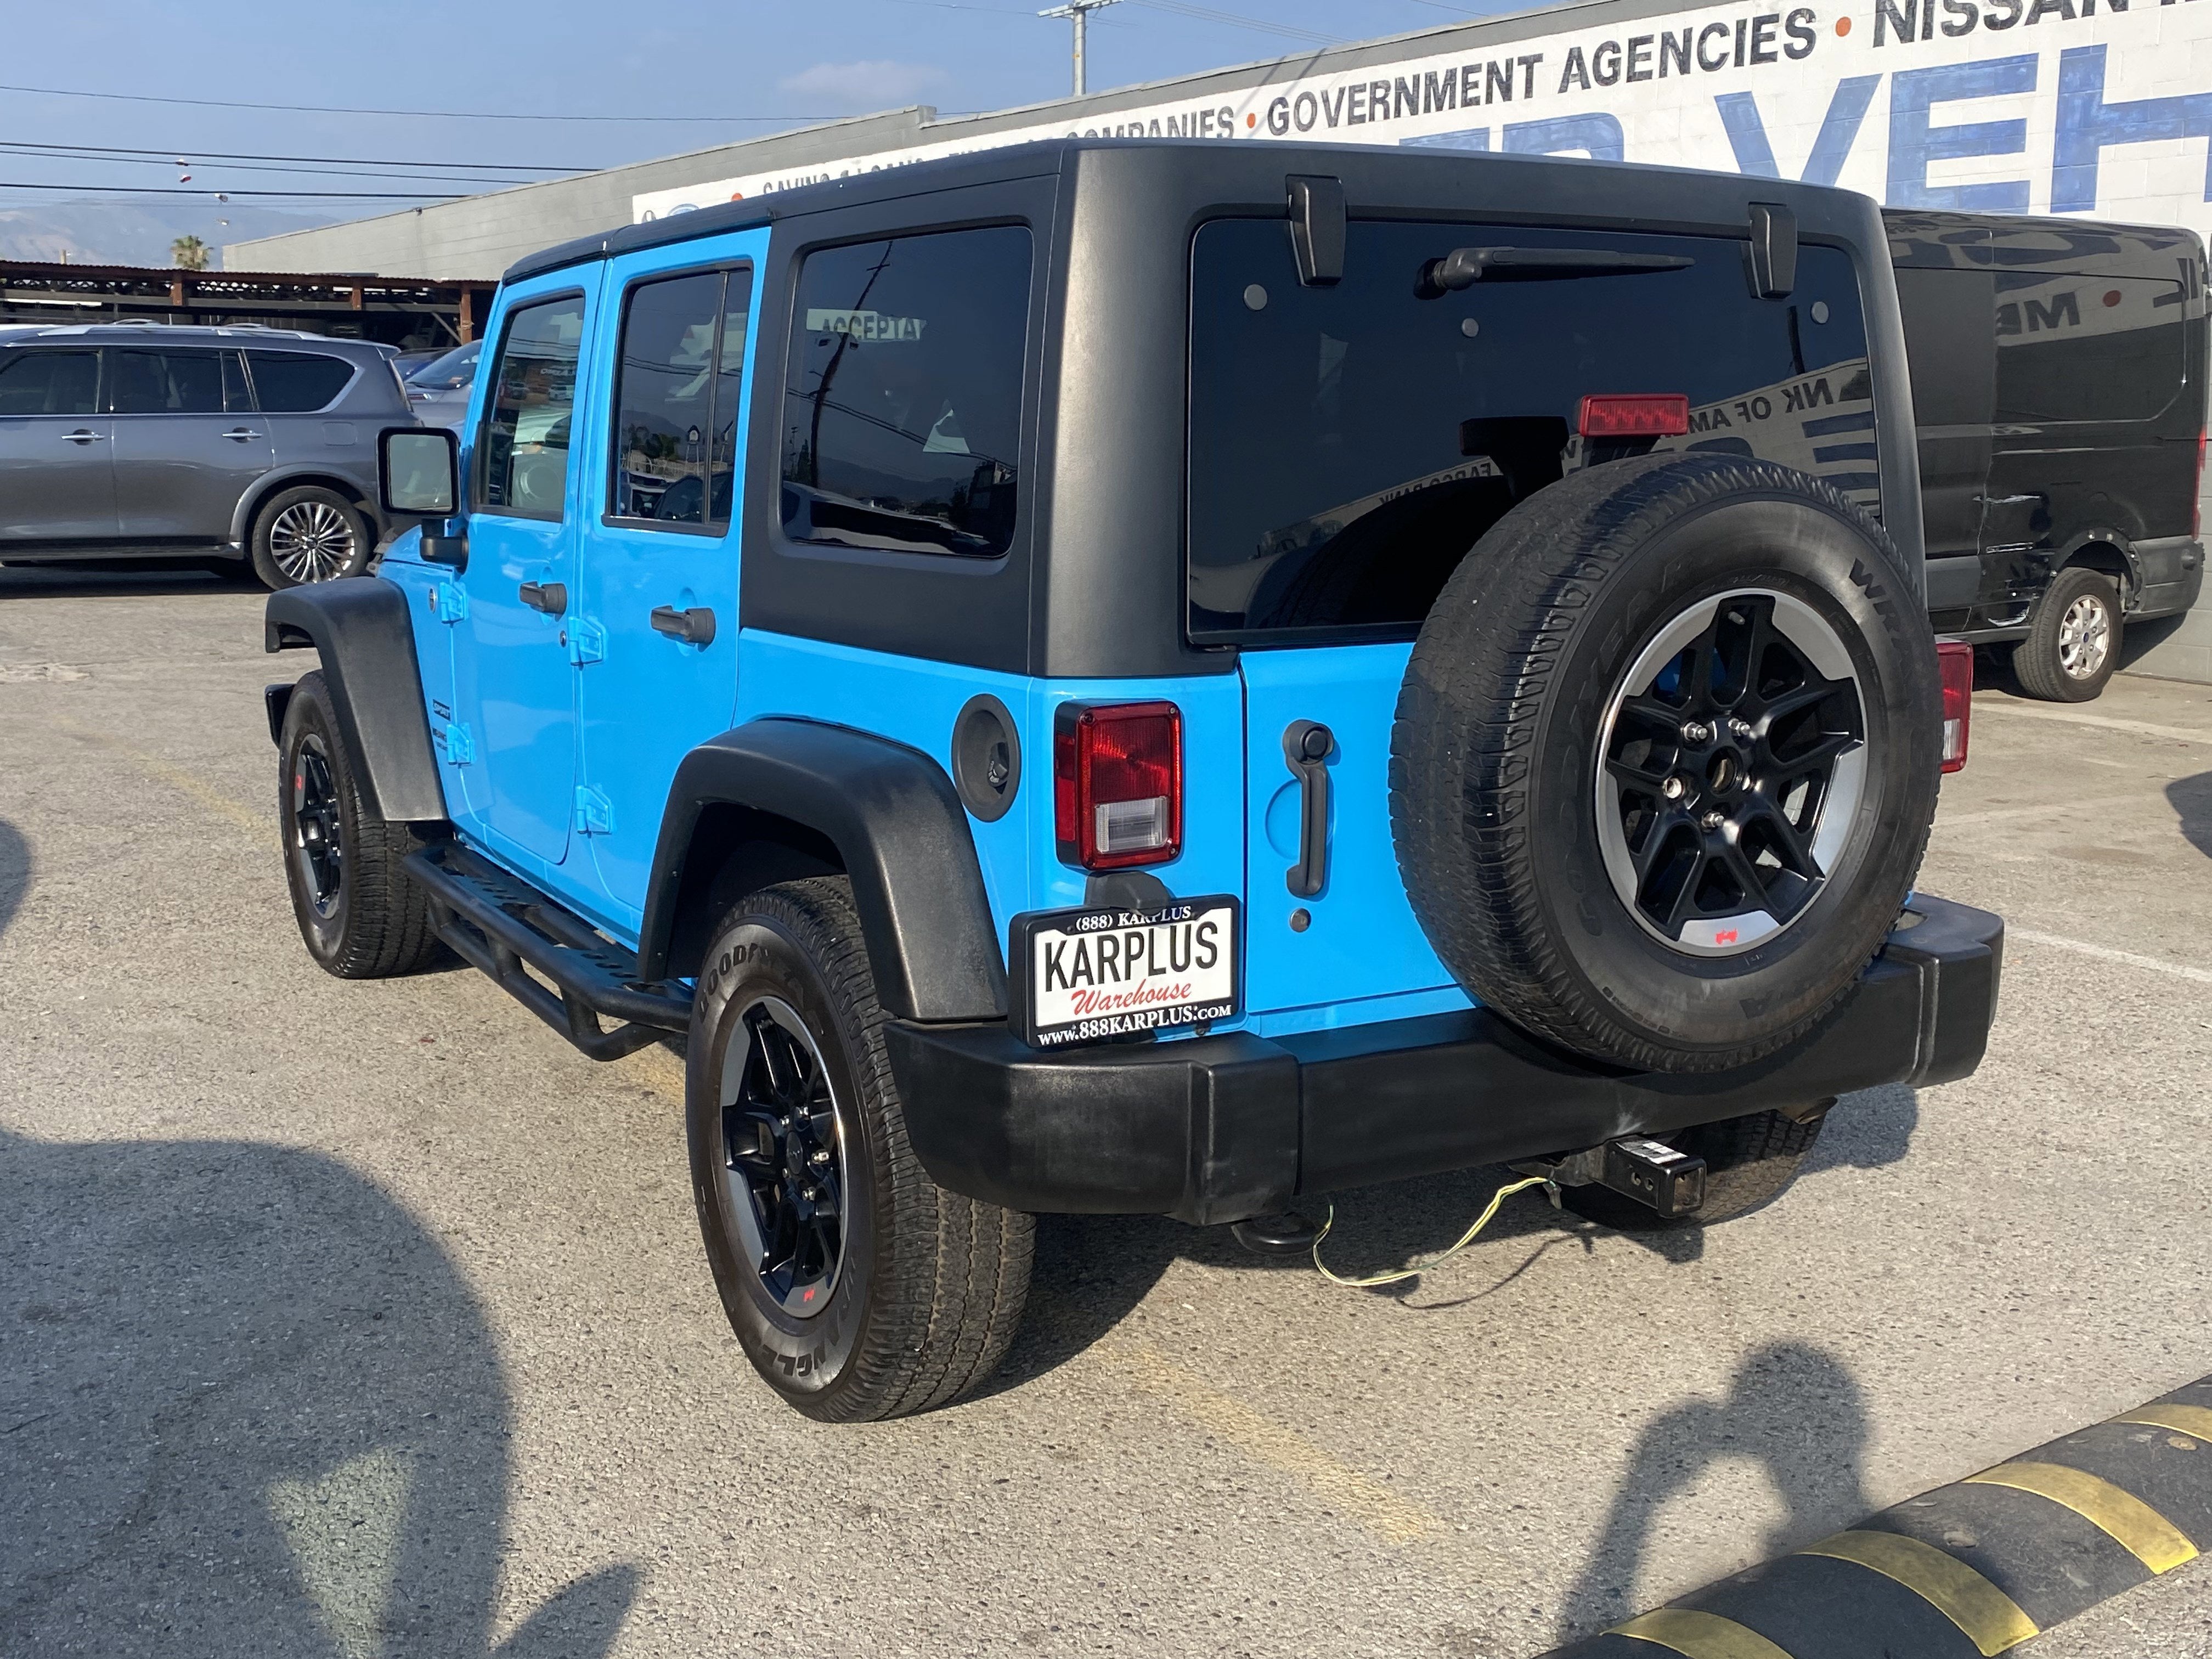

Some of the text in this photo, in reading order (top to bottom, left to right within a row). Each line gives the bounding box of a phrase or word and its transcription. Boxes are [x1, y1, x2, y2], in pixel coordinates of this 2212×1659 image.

[1267, 53, 1543, 136] GOVERNMENT
[1558, 8, 1817, 94] AGENCIES
[1075, 915, 1113, 931] (888)
[1045, 921, 1218, 992] KARPLUS
[1071, 978, 1192, 1015] Warehouse
